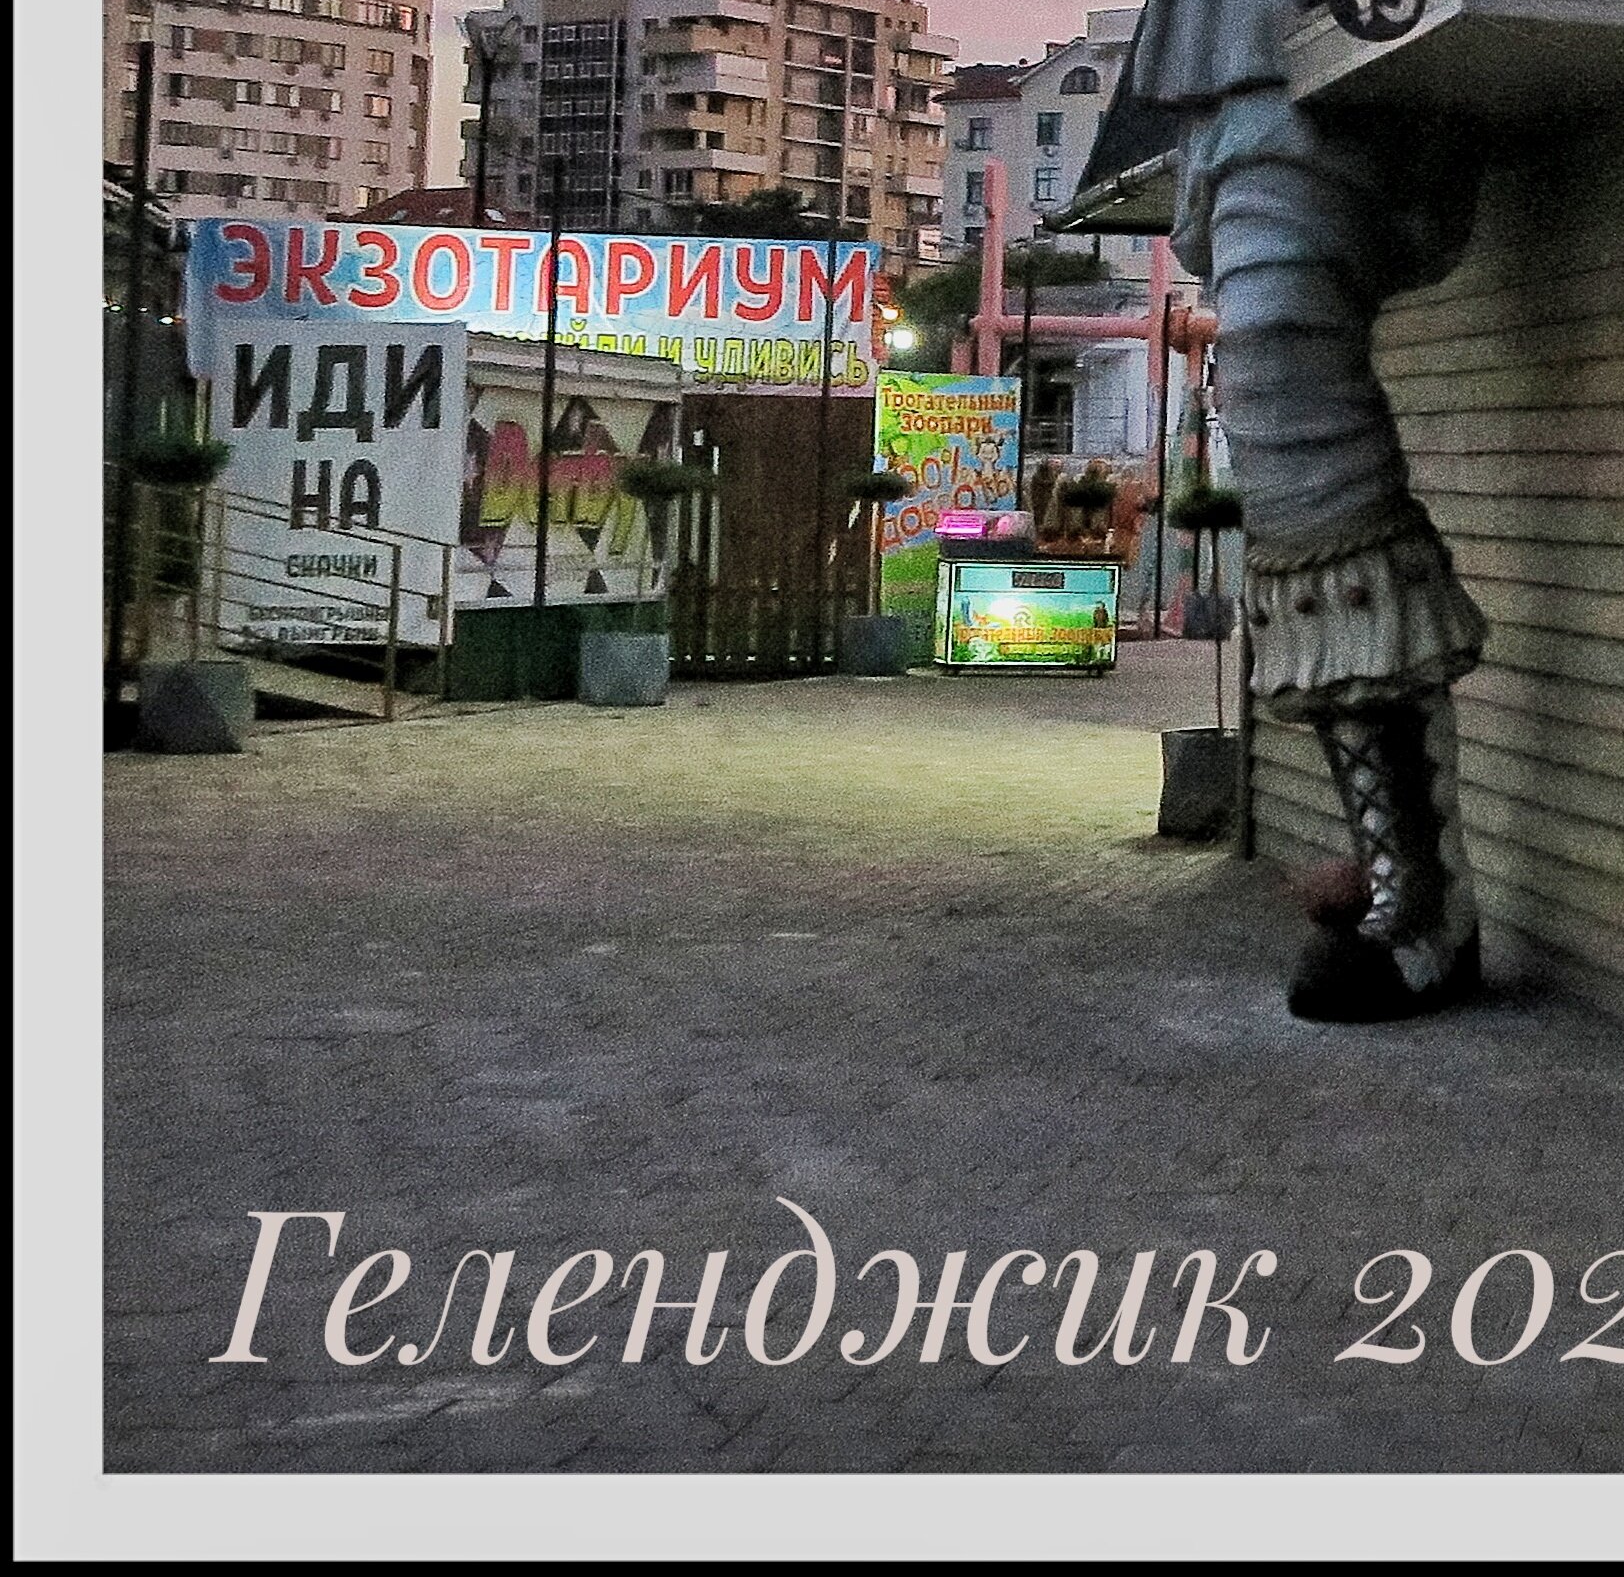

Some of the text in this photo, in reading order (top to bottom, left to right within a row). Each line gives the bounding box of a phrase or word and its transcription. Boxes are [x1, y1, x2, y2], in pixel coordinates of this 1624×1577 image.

[214, 223, 866, 321] ЭКЗОТАРИУМ
[233, 344, 444, 442] ИДИ
[694, 337, 870, 387] УДИВИСЬ
[290, 459, 381, 530] НА
